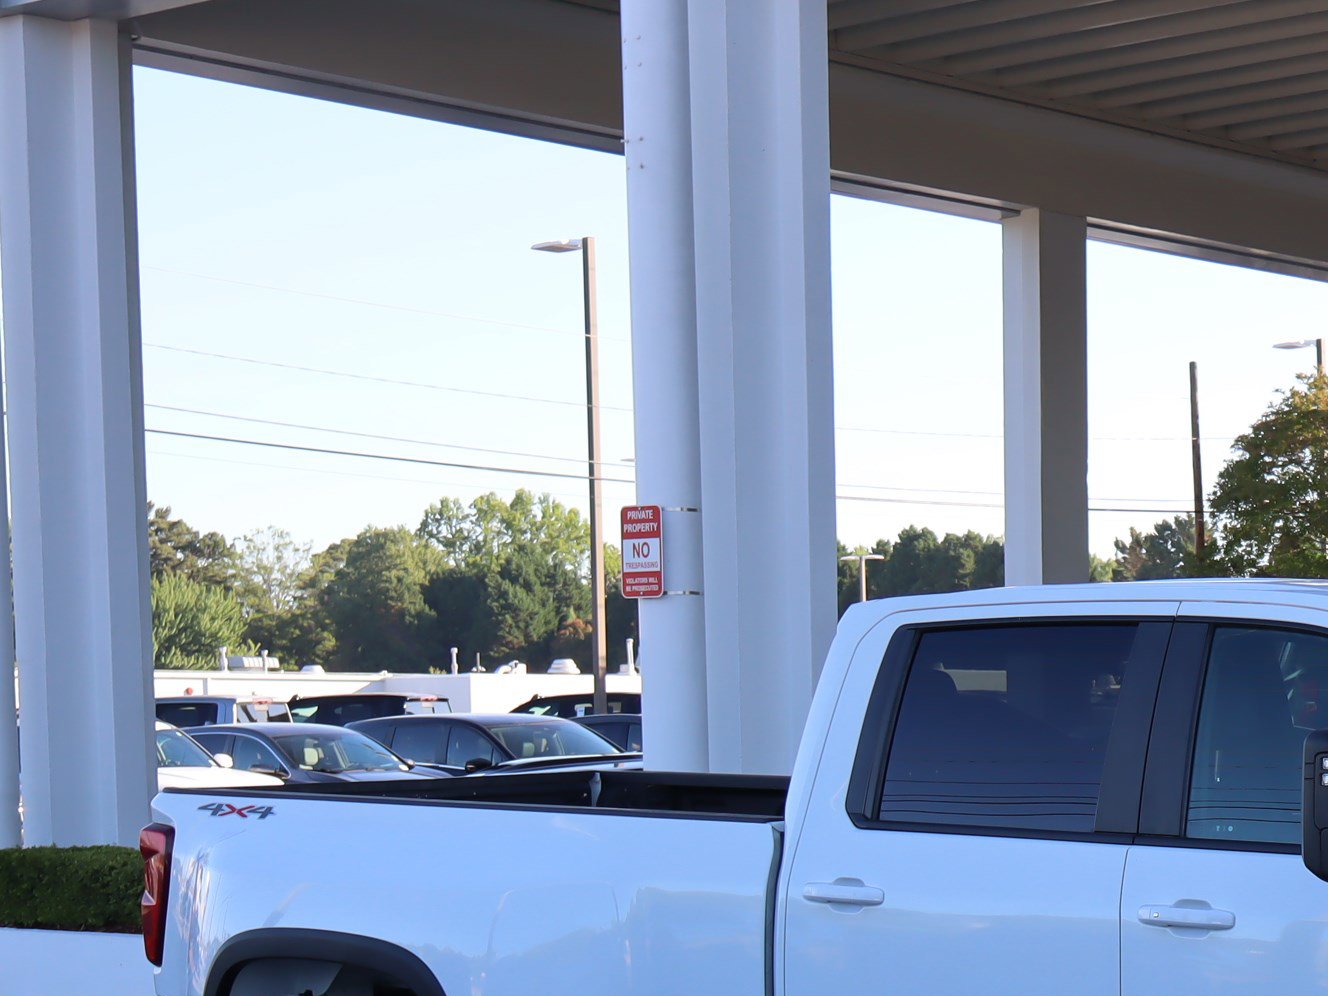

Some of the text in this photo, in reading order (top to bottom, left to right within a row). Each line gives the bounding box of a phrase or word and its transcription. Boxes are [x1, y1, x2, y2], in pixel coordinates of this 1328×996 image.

[627, 509, 654, 520] PRIVATE
[623, 522, 658, 533] PROPERTY
[632, 541, 650, 559] NO
[625, 561, 658, 569] TRESPASSING
